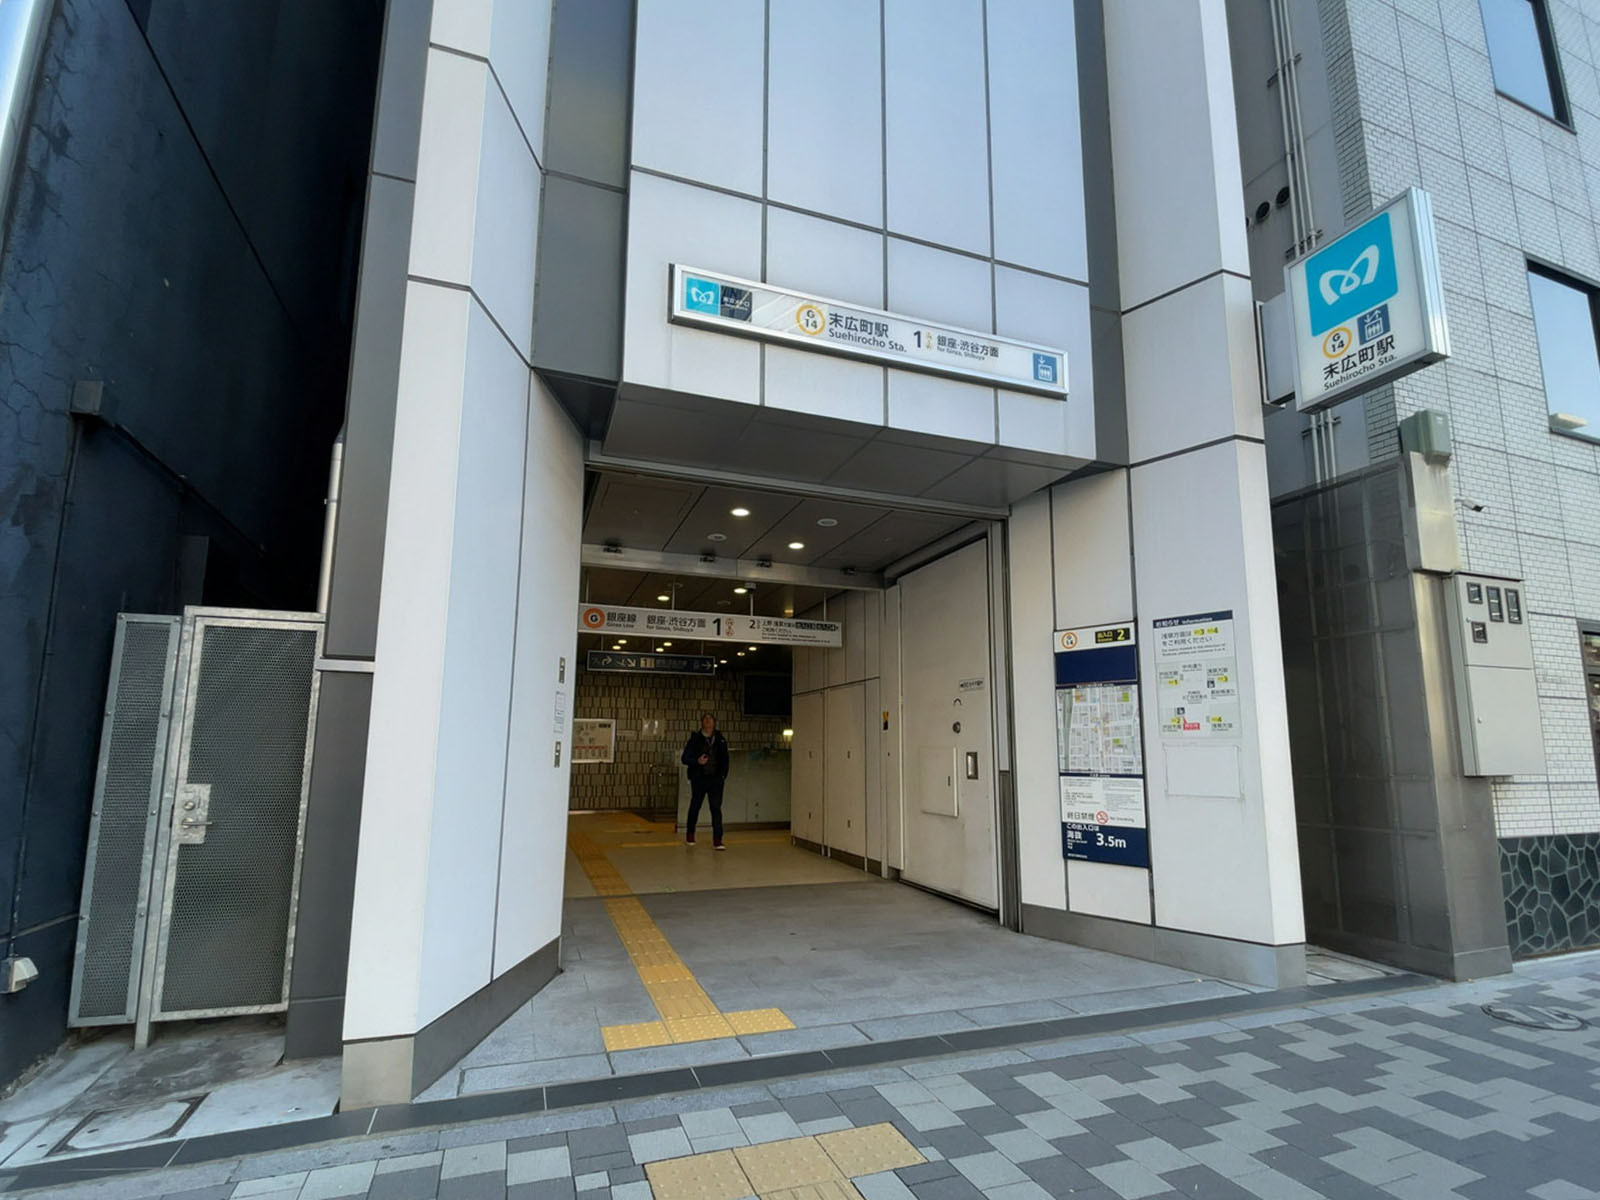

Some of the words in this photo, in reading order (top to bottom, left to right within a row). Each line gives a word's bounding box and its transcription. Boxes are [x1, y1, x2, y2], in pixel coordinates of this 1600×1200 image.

[806, 309, 815, 319] G
[804, 318, 818, 329] 14
[828, 312, 889, 339] 末広町駅
[828, 328, 886, 348] Suehirocho
[888, 340, 907, 352] Sta.
[913, 330, 921, 348] 1
[1332, 333, 1341, 342] G
[1331, 340, 1345, 352] 14
[1322, 334, 1396, 380] 末広町駅
[1323, 363, 1376, 391] Suehirocho
[1378, 354, 1398, 366] Sta.
[590, 614, 598, 622] G
[749, 620, 756, 629] 2
[712, 617, 721, 636] 1
[1117, 629, 1125, 641] 2
[1096, 832, 1127, 849] 3.5m
